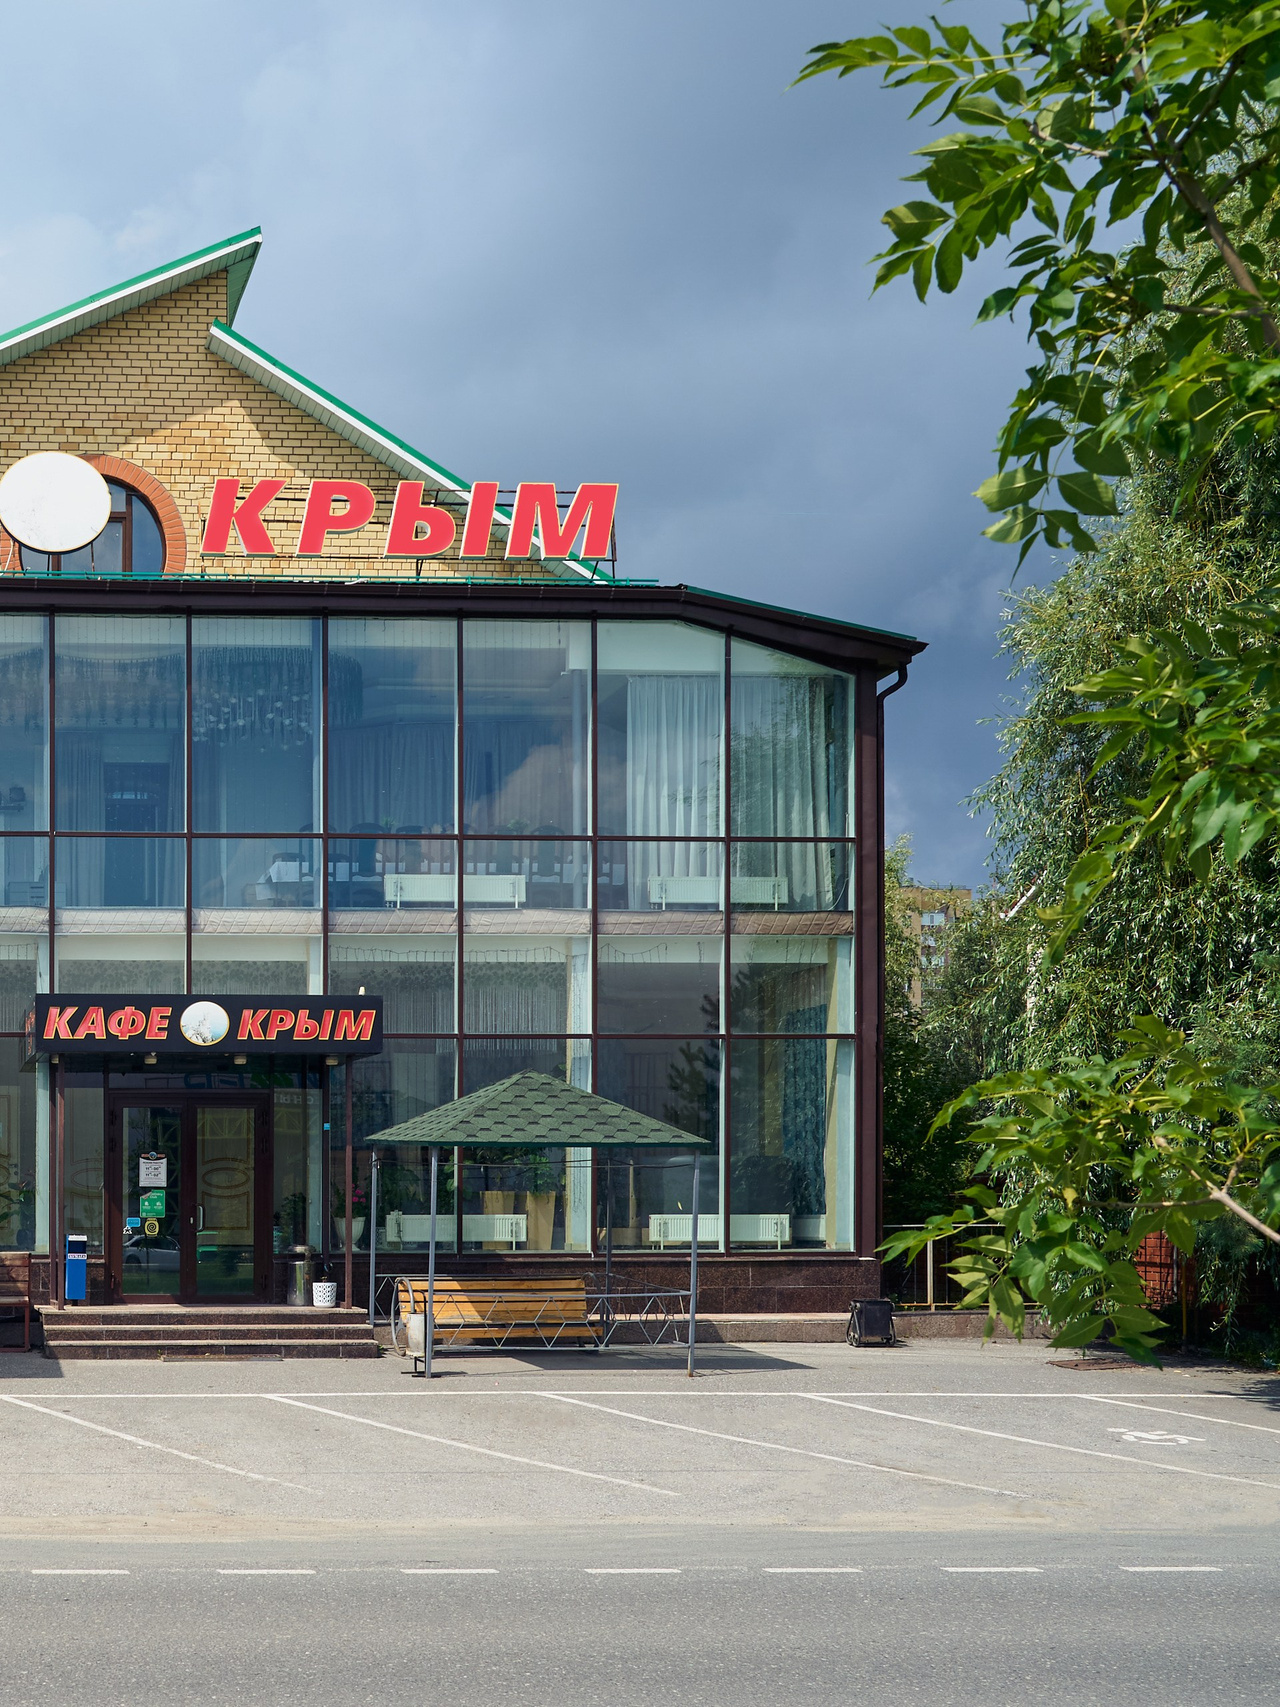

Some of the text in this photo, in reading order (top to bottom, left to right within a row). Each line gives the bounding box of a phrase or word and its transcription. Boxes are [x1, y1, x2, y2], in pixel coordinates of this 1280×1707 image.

[200, 478, 619, 560] КРЫМ
[43, 1006, 173, 1040] КАФЕ
[237, 1009, 377, 1041] КРЫМ
